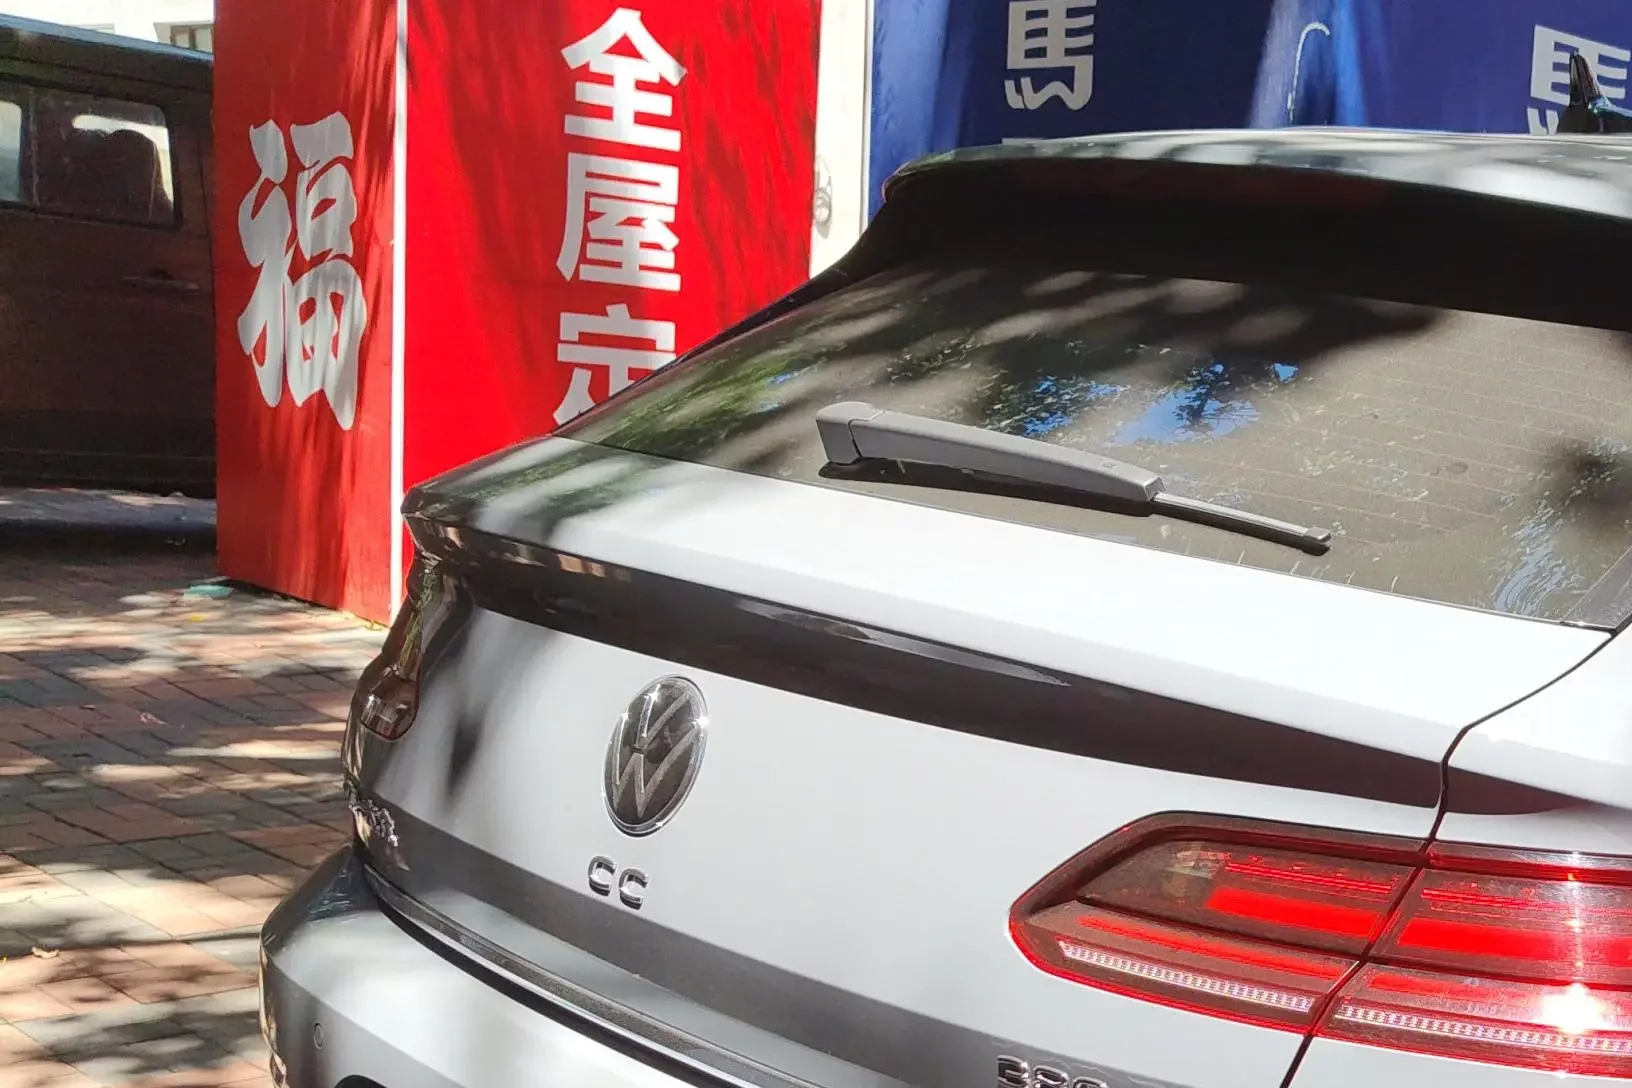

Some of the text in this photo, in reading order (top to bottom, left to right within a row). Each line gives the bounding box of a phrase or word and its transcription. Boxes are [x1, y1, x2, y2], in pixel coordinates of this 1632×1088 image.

[237, 111, 367, 430] 福
[552, 7, 687, 427] 全屋定
[587, 854, 651, 911] CC
